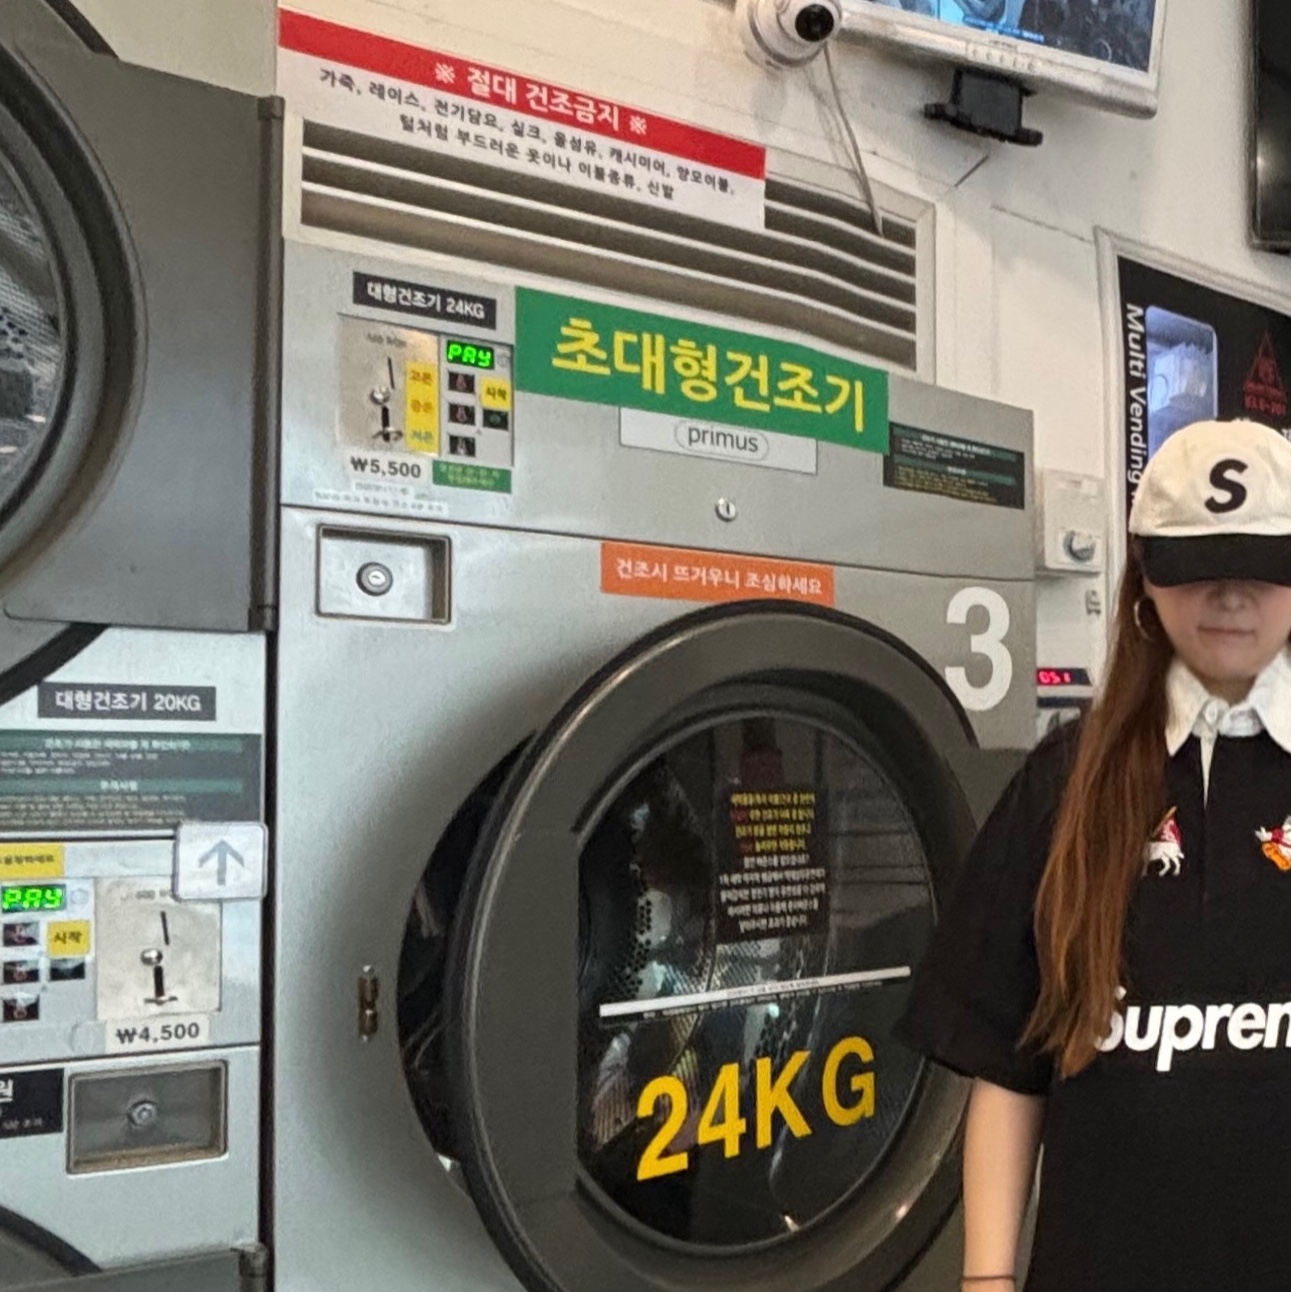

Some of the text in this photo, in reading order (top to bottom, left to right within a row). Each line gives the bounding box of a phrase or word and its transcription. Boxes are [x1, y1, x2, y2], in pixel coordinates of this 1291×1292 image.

[467, 66, 619, 132] 절대 건조금지
[456, 128, 521, 160] 부드러운
[366, 280, 486, 320] 대형건조기 24KG
[447, 342, 493, 368] PAY
[551, 317, 868, 435] 초대형건조기
[1125, 303, 1149, 484] Multi Vending
[687, 422, 760, 454] primus
[351, 455, 421, 478] ₩5,500
[1204, 458, 1249, 514] S
[615, 559, 824, 597] 건조시 뜨거우니 조심하세요
[943, 586, 1014, 713] 3
[55, 689, 202, 712] 대형건조기 20KG
[116, 1021, 201, 1046] ₩4,500
[636, 1035, 877, 1182] 24KG
